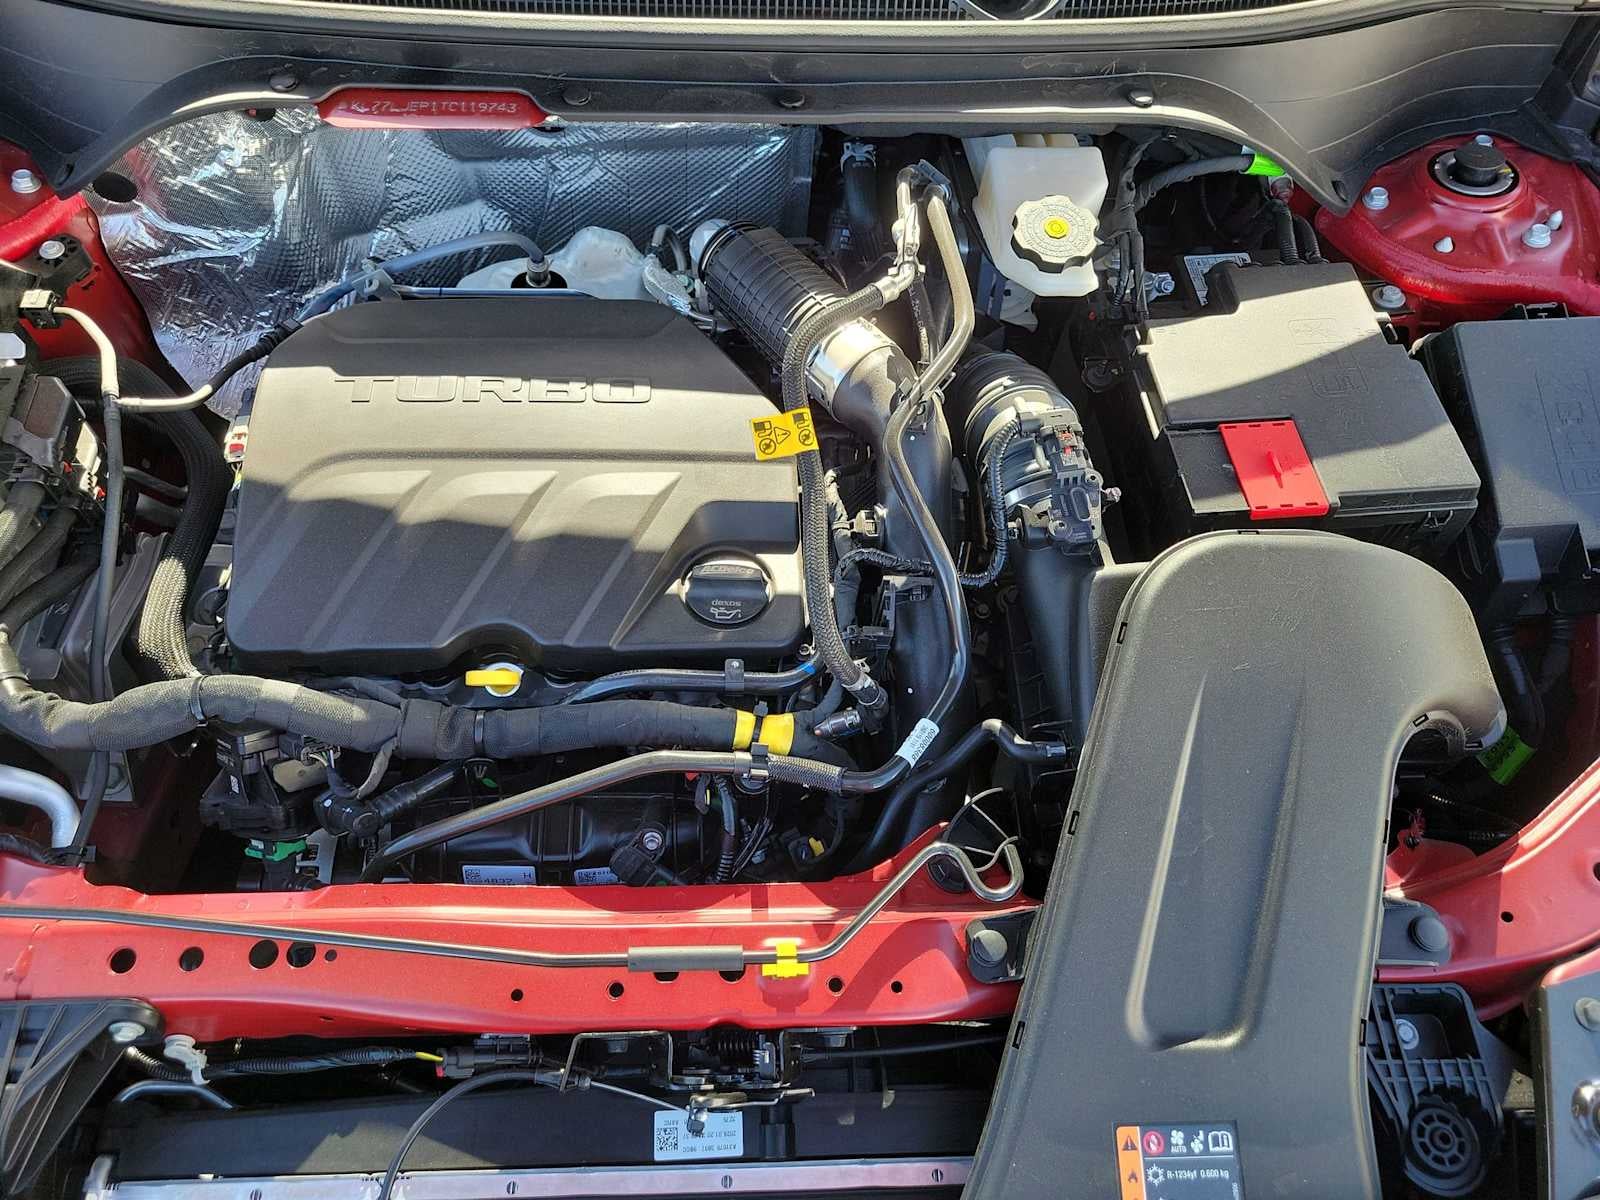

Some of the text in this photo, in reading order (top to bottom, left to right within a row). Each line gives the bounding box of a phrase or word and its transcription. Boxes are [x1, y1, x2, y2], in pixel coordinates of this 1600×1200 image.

[335, 376, 652, 403] TURBO
[711, 599, 742, 607] dexos
[1170, 1145, 1187, 1153] AUTO
